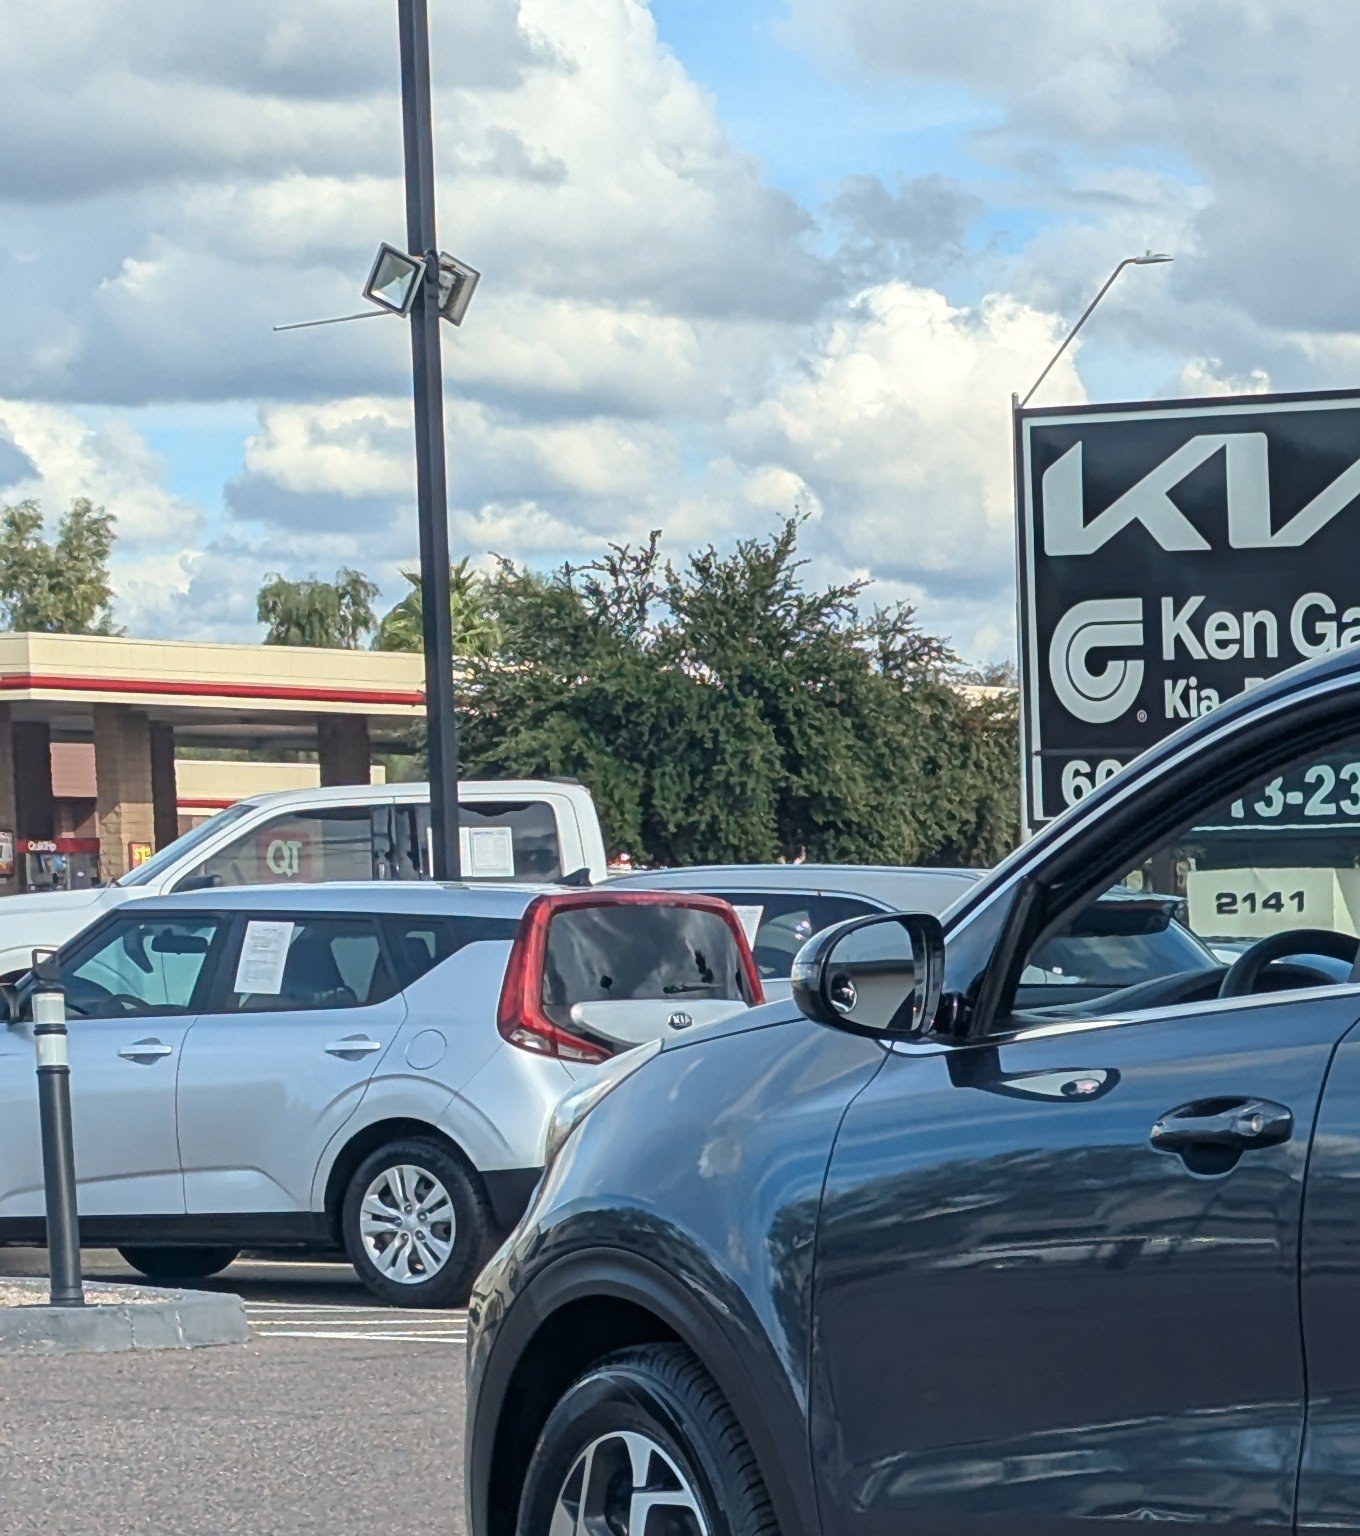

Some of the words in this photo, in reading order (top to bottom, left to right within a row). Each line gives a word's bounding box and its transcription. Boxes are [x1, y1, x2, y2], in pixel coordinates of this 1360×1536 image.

[1161, 595, 1278, 660] Ken
[1164, 677, 1221, 719] Kia
[266, 839, 302, 877] QT
[1215, 890, 1306, 915] 2141
